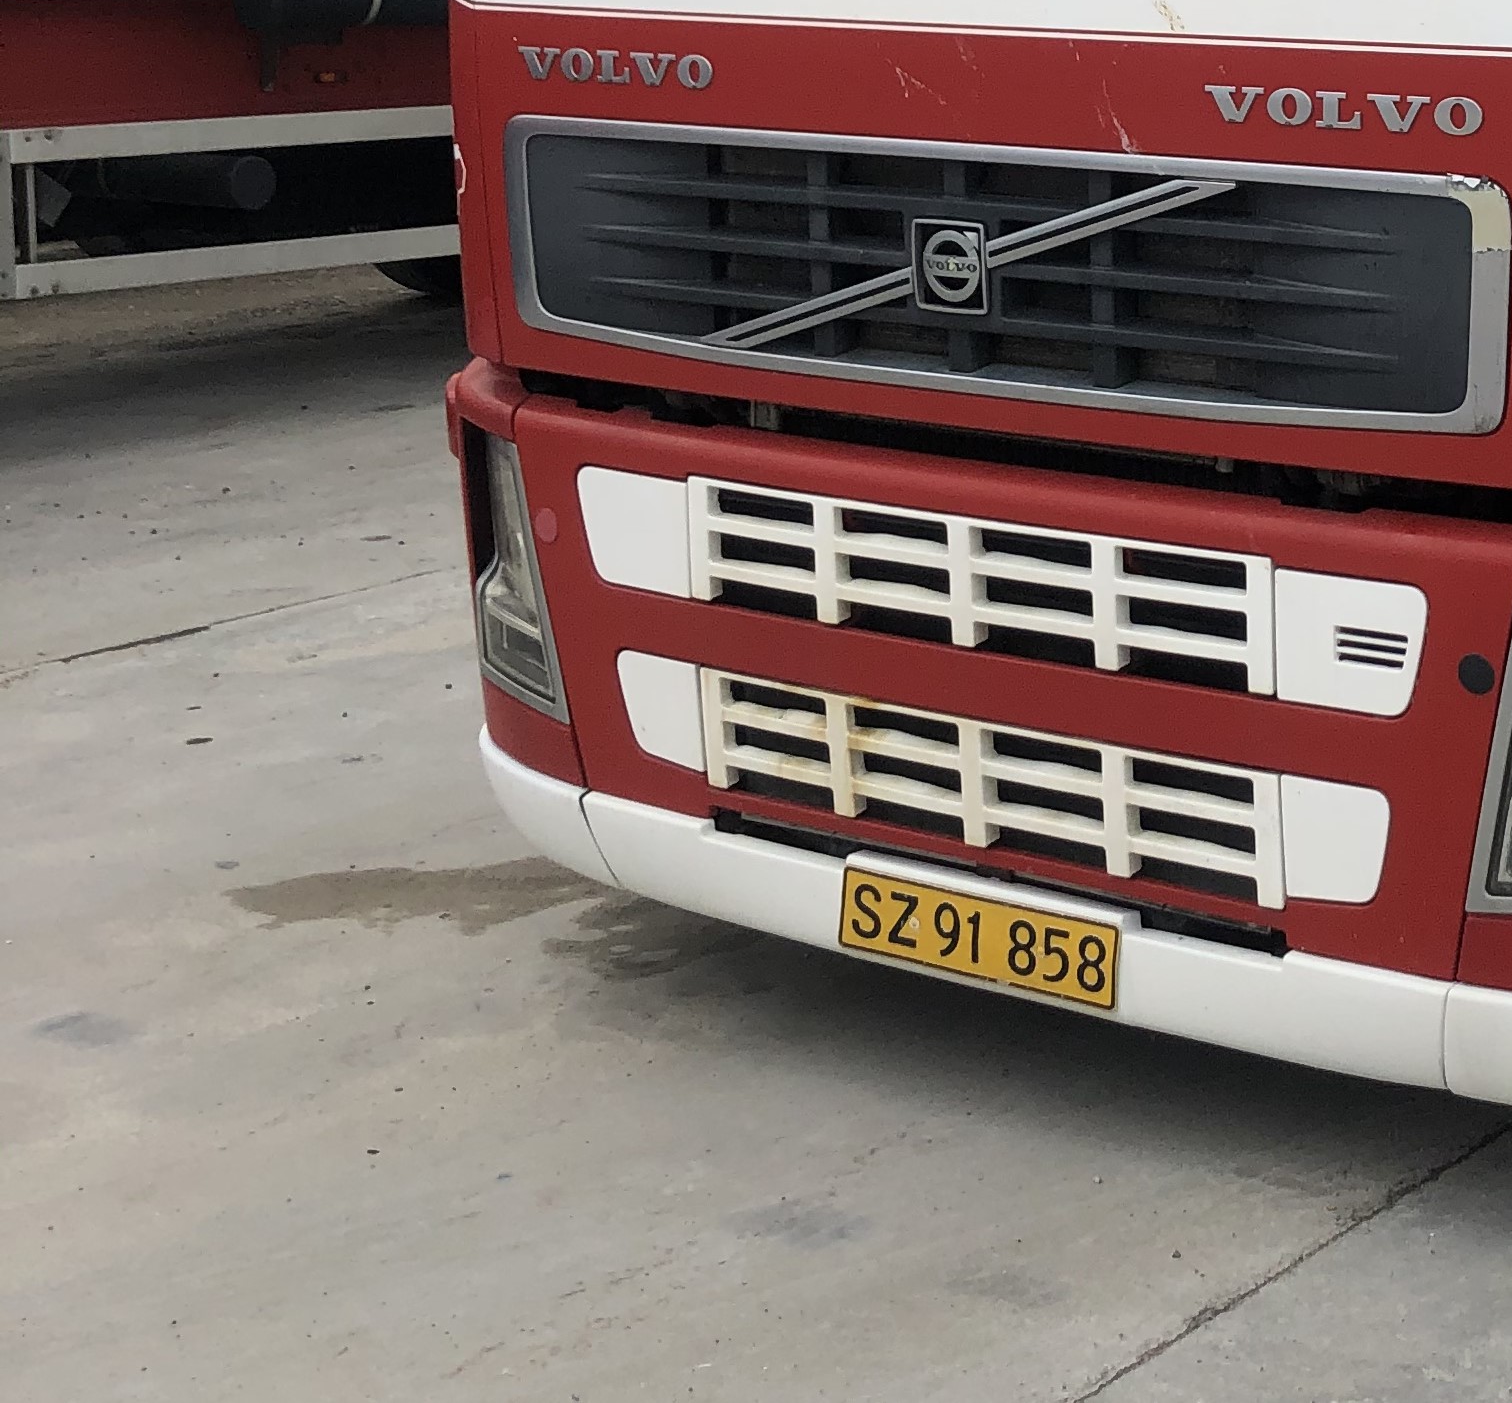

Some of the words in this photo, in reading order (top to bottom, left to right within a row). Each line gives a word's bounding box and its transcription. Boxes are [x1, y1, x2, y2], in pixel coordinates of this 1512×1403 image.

[518, 45, 714, 90] VOLVO
[1205, 86, 1484, 136] VOLVO
[925, 258, 978, 273] VOLVO
[851, 883, 919, 948] SZ
[934, 902, 980, 964] 91
[1008, 919, 1106, 993] 858
